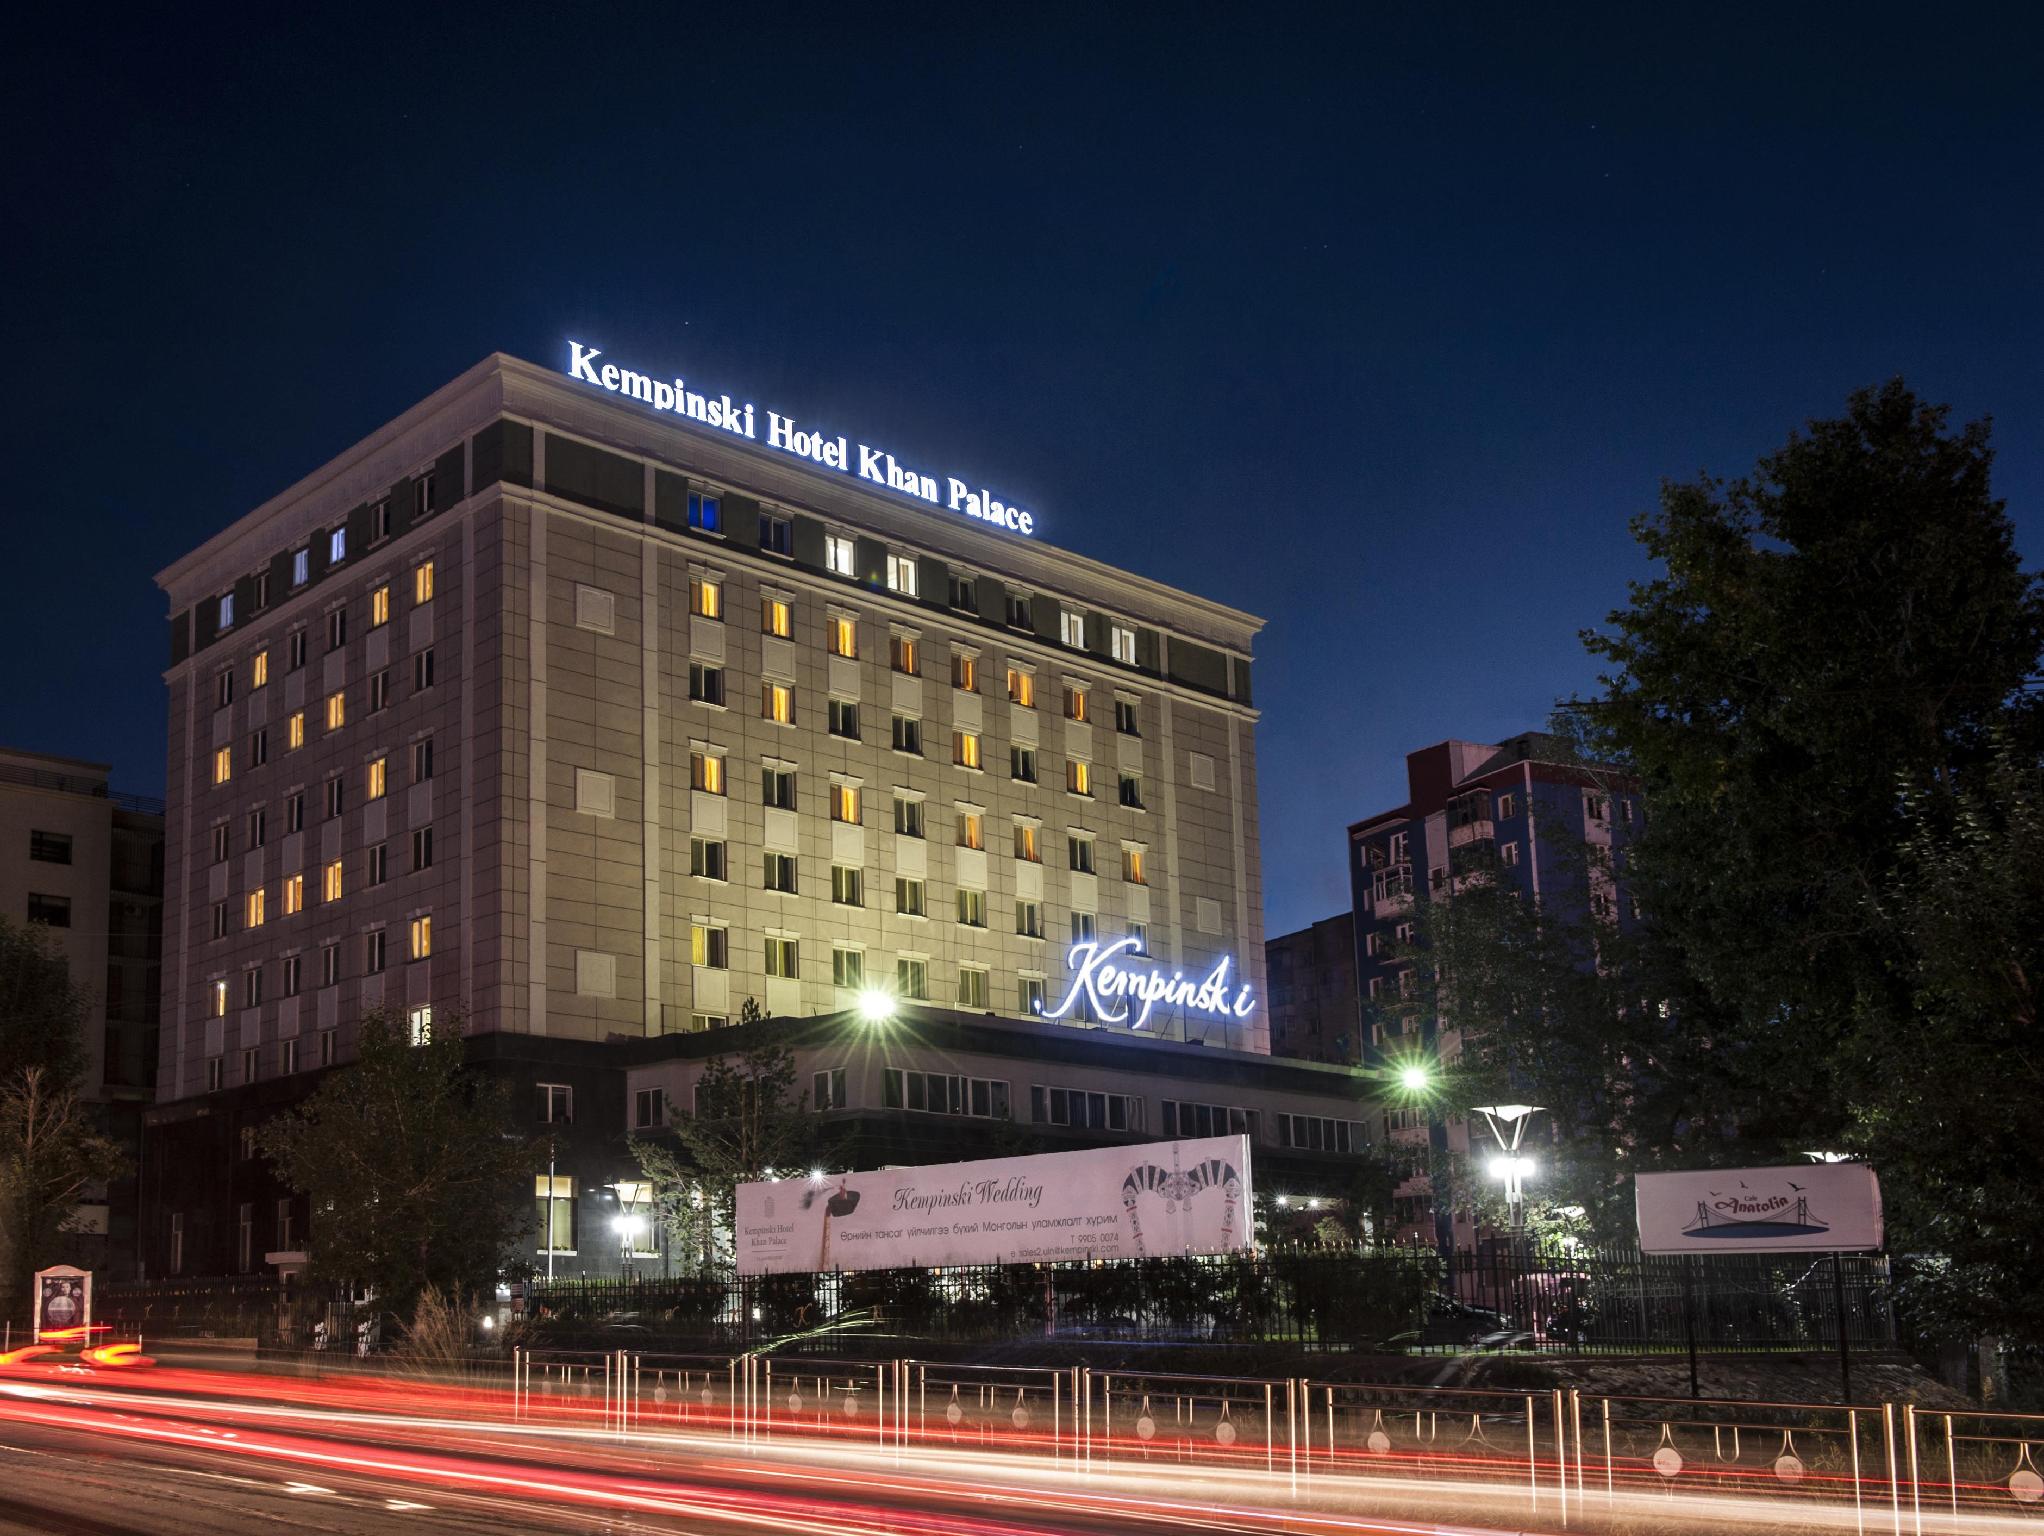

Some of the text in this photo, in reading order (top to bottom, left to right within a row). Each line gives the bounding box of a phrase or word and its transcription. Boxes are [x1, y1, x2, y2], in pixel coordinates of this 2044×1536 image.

[567, 340, 1034, 535] Kempinski Hotel Khan Palace
[1034, 938, 1255, 1029] Kempinski
[892, 1175, 1043, 1216] Kempinski Wedding
[982, 1220, 1028, 1233] Монголын
[1086, 1215, 1118, 1228] хурим
